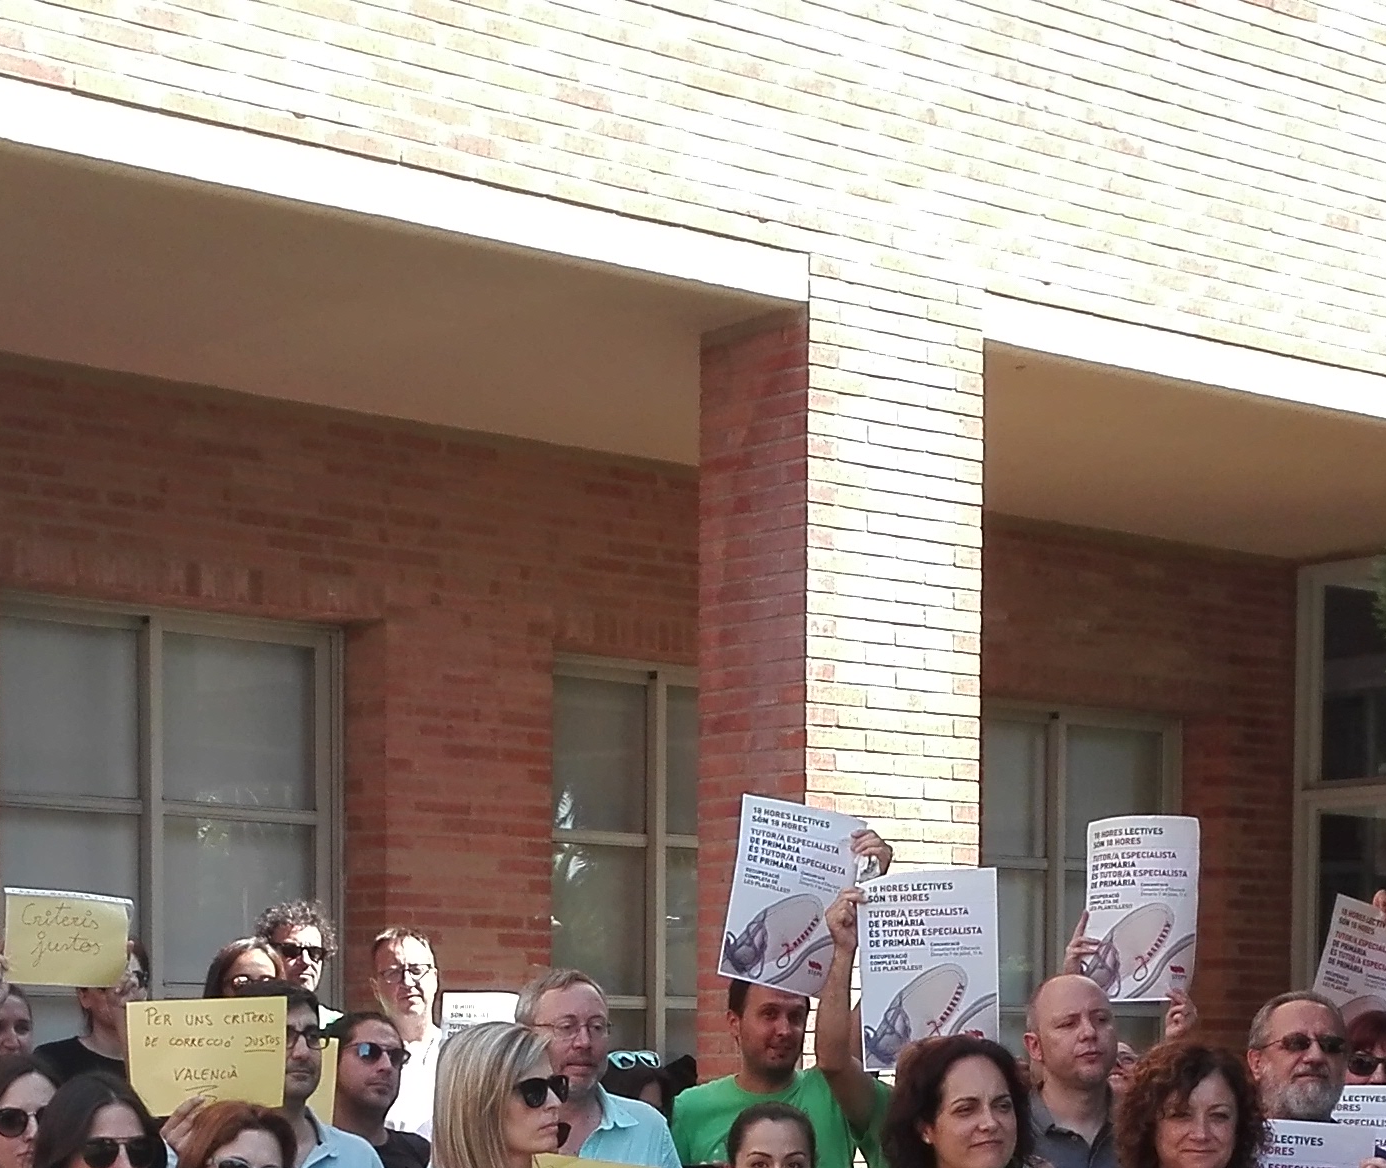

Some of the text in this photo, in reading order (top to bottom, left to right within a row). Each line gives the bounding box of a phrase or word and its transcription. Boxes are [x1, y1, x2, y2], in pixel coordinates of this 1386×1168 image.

[22, 903, 98, 929] Criteris
[31, 931, 100, 967] justos
[145, 1007, 172, 1025] PER
[185, 1014, 213, 1025] UNS
[145, 1036, 158, 1047] DE
[244, 1035, 280, 1047] JUSTOS
[174, 1065, 238, 1081] VALENCIÀ
[1274, 1135, 1324, 1146] LECTIVES
